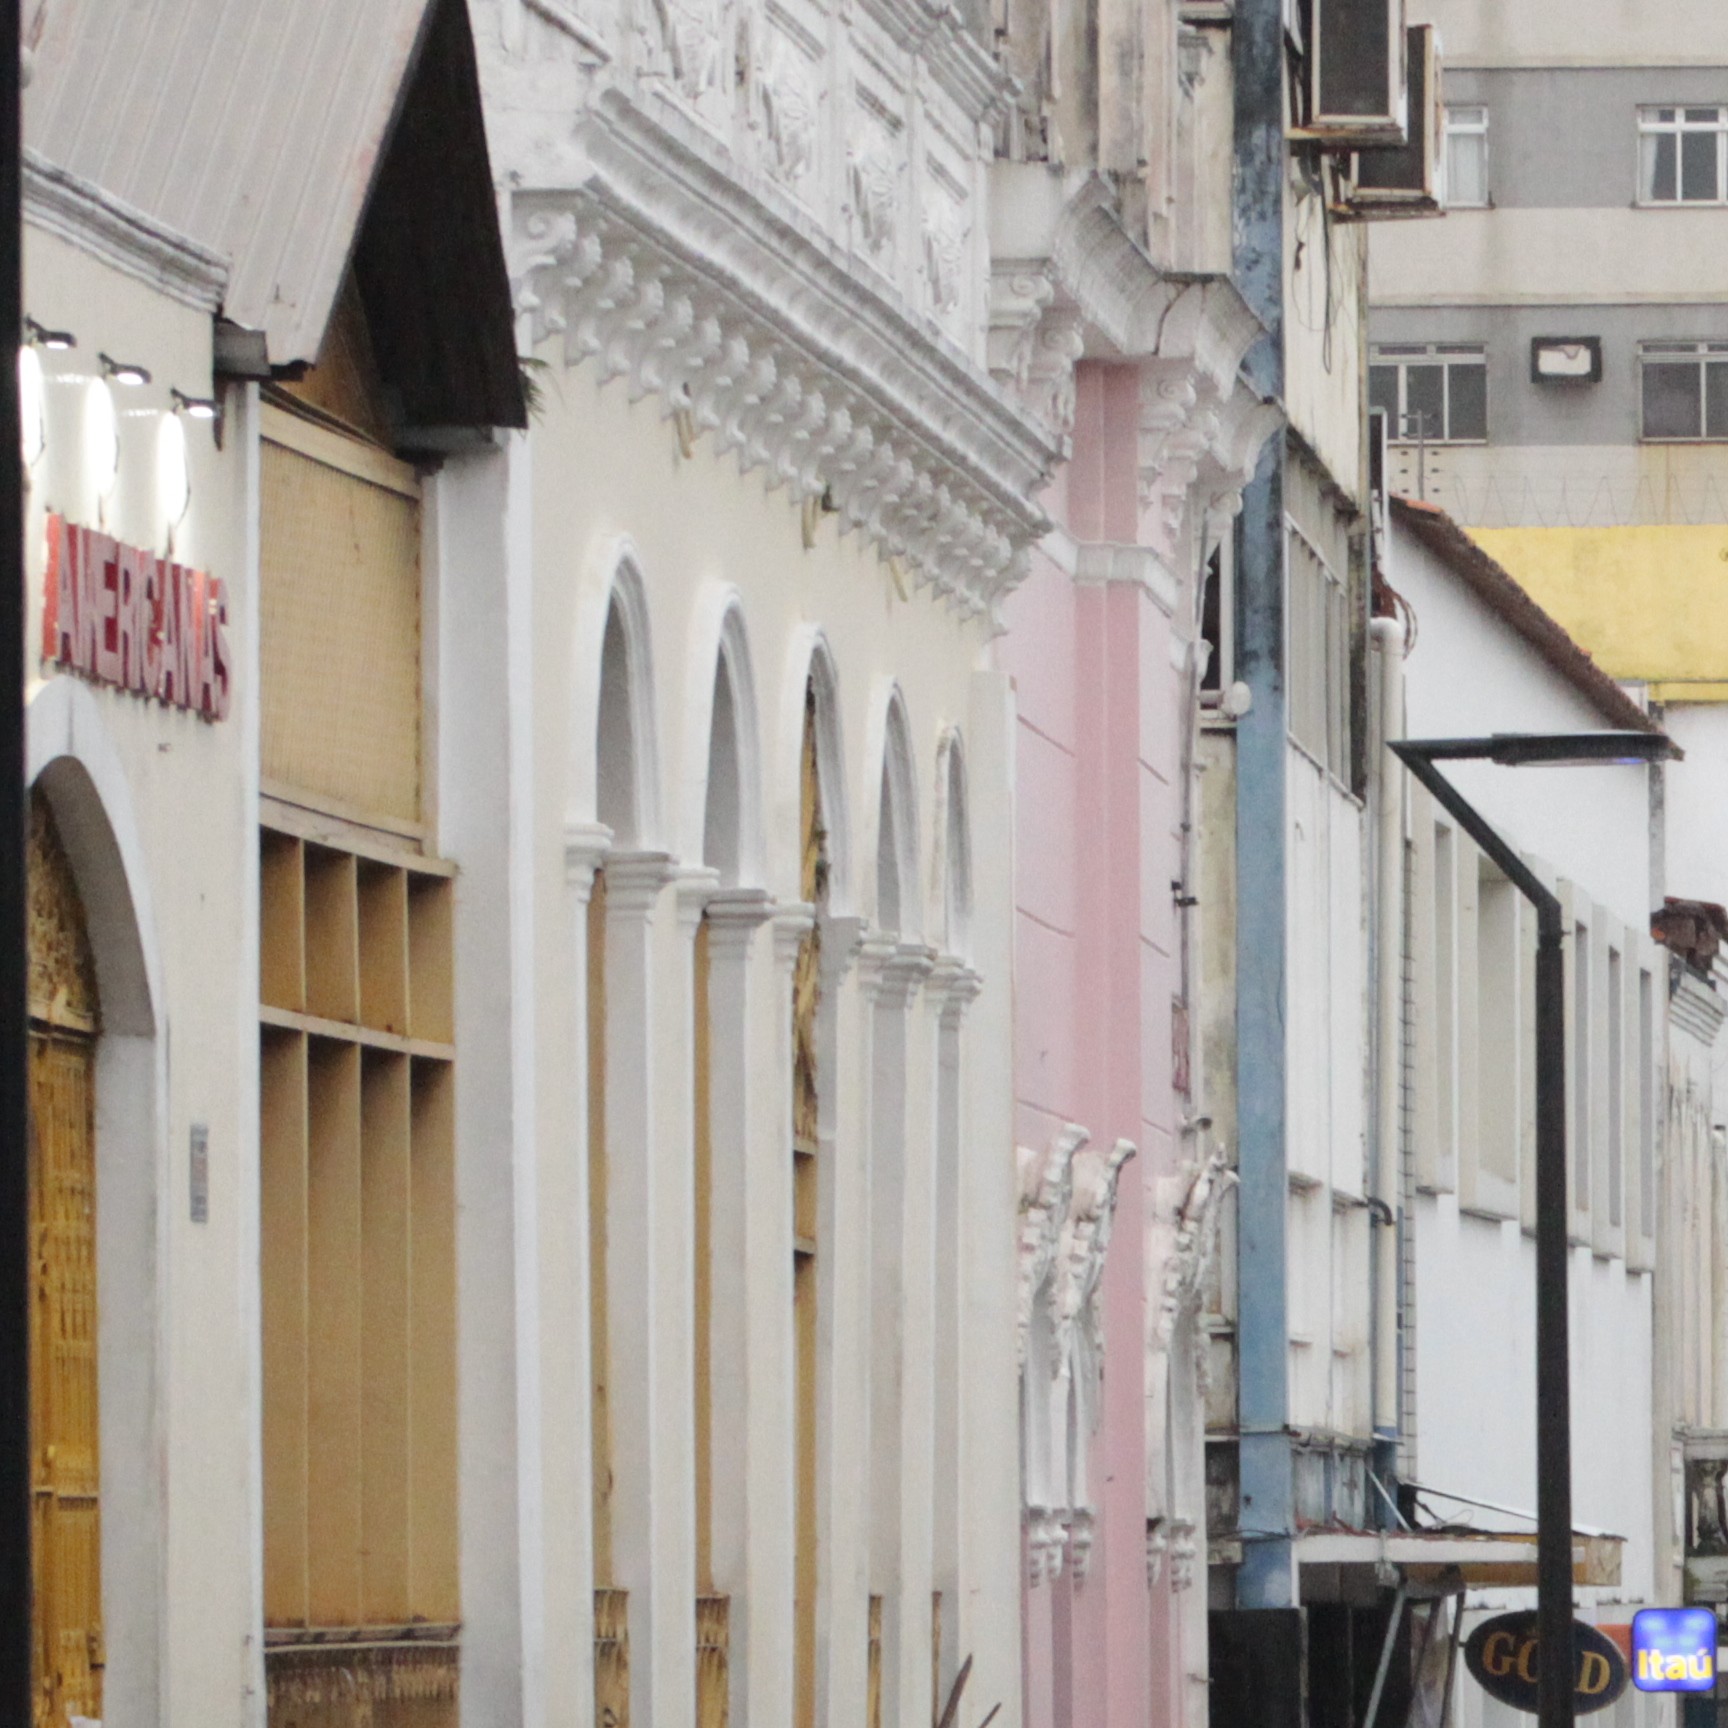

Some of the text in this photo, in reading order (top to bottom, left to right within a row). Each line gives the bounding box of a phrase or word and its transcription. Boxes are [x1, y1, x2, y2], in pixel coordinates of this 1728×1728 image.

[52, 514, 231, 722] AMERICANAS
[1482, 1631, 1611, 1694] GOD
[1638, 1647, 1713, 1681] Itaú
